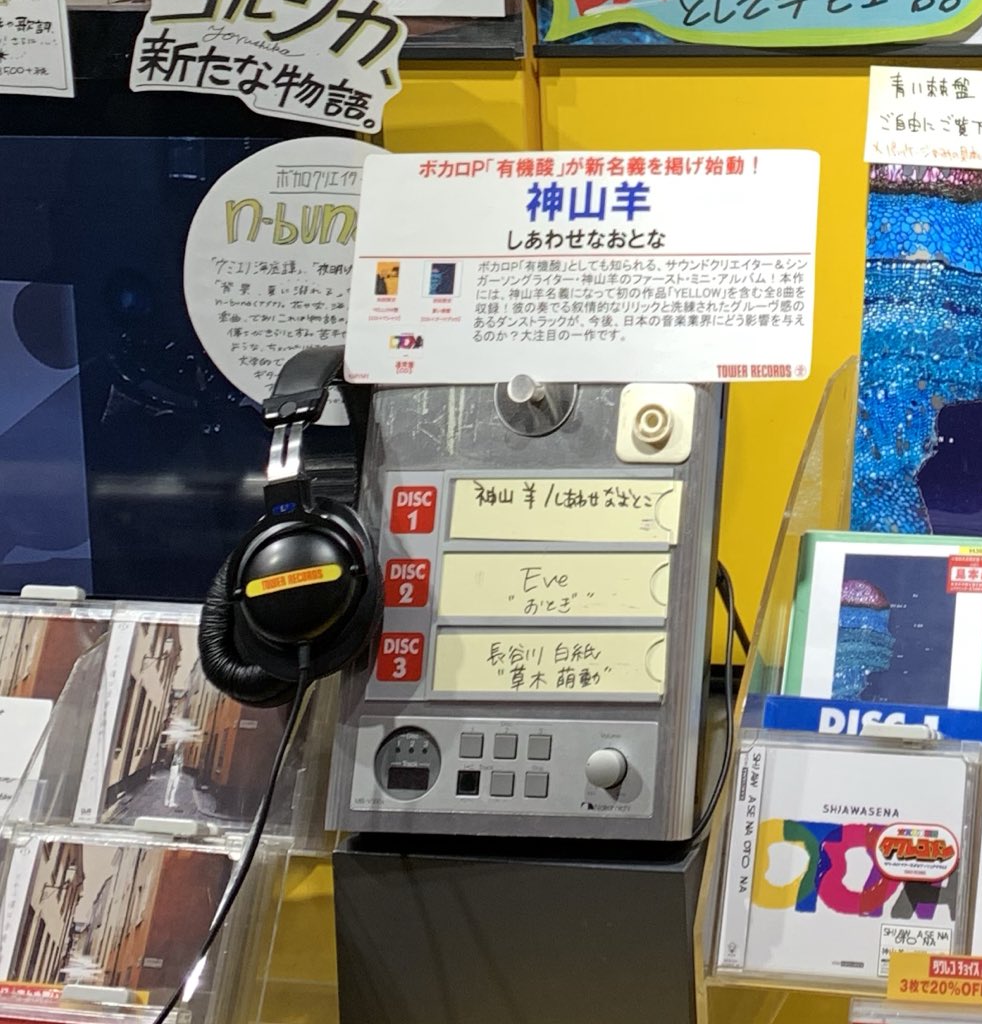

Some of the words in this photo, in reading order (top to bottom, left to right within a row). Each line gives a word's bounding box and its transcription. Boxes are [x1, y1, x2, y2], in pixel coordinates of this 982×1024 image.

[137, 27, 376, 128] 新たな物語。
[418, 155, 761, 179] ボカロP「有機酸」が新名義を掲げ始動!
[526, 180, 652, 222] 神山羊
[225, 198, 358, 246] n-bun
[507, 229, 666, 251] しあわせなおとな
[716, 364, 748, 378] TOWER
[750, 364, 792, 378] RECORDS
[397, 492, 432, 507] DISC
[407, 510, 418, 531] 1
[261, 576, 286, 590] TOWER
[287, 569, 323, 585] RECORDS
[390, 564, 426, 580] DISC
[521, 567, 568, 592] Eve
[399, 582, 413, 605] 2
[384, 638, 420, 654] DISC
[392, 657, 407, 678] 3
[822, 804, 900, 818] SHIAWASENA
